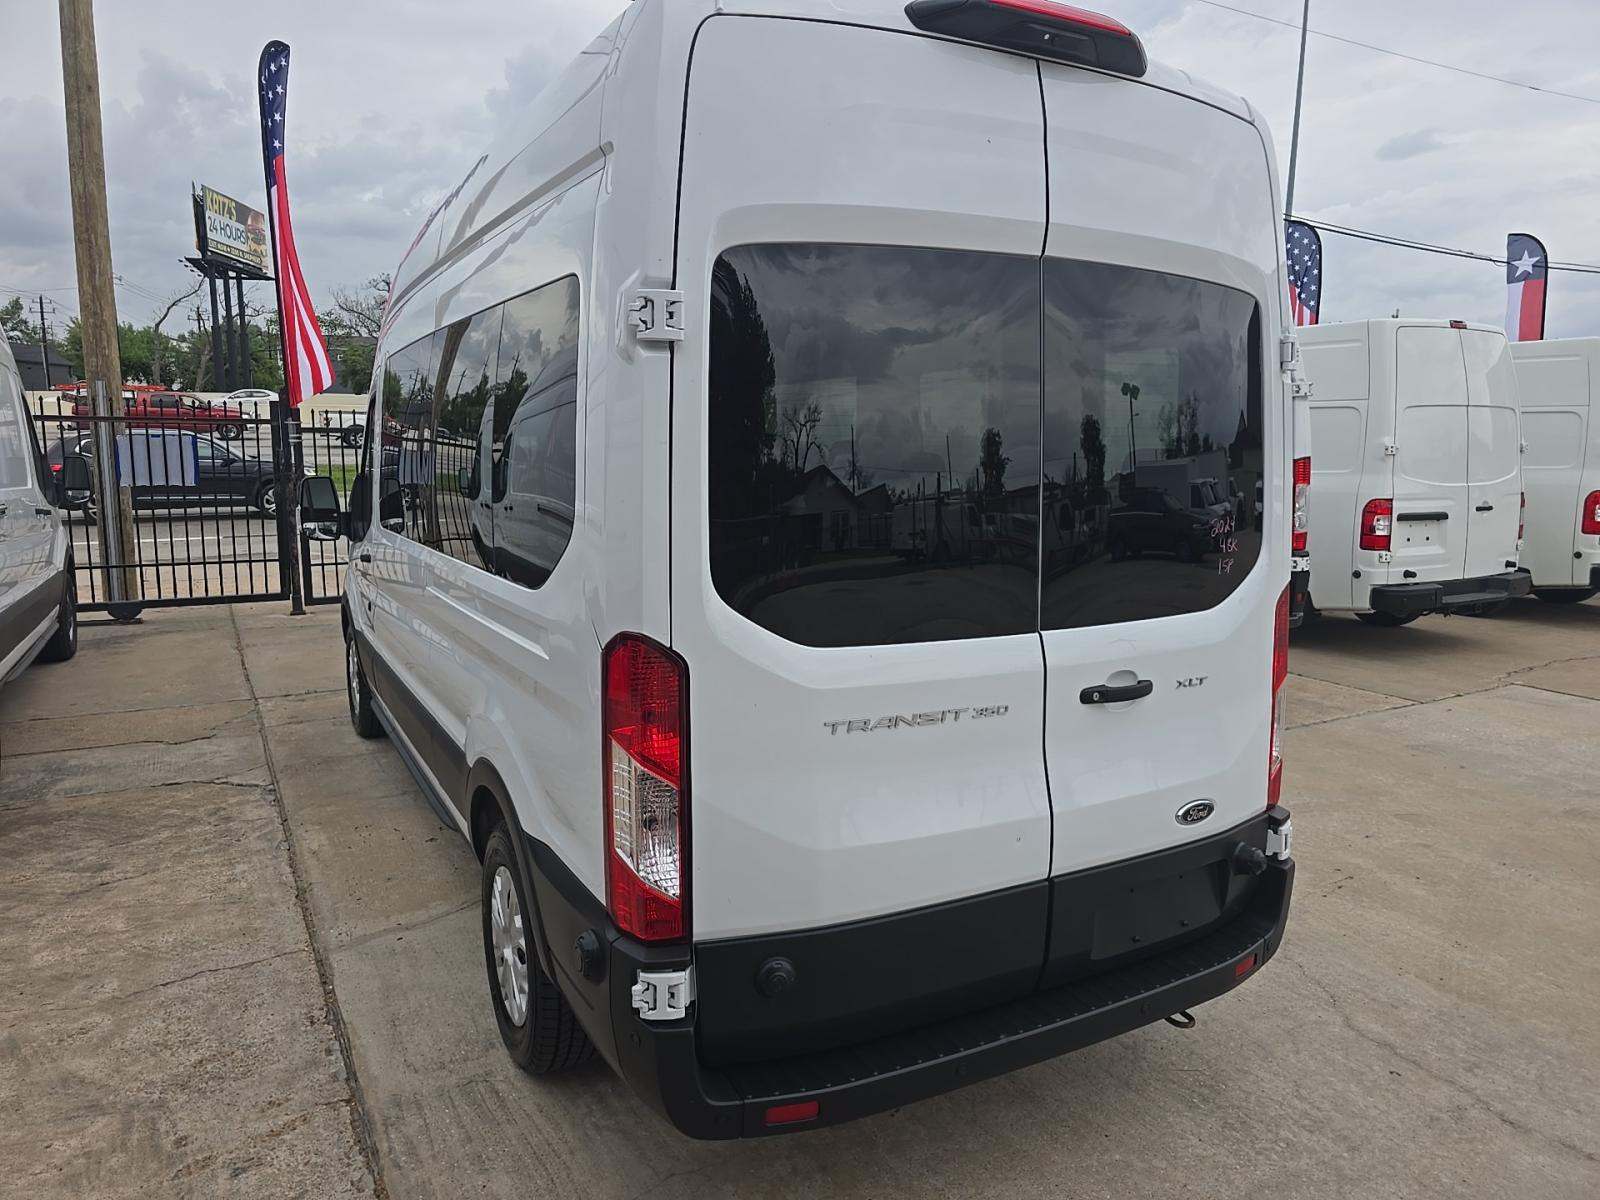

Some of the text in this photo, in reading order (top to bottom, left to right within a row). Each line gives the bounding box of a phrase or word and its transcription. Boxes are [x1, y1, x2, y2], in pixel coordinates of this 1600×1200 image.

[205, 188, 237, 222] KATZ'S
[208, 215, 246, 245] 24 HOURS
[1175, 675, 1209, 690] XLT
[824, 704, 1009, 737] TRANSIT 350
